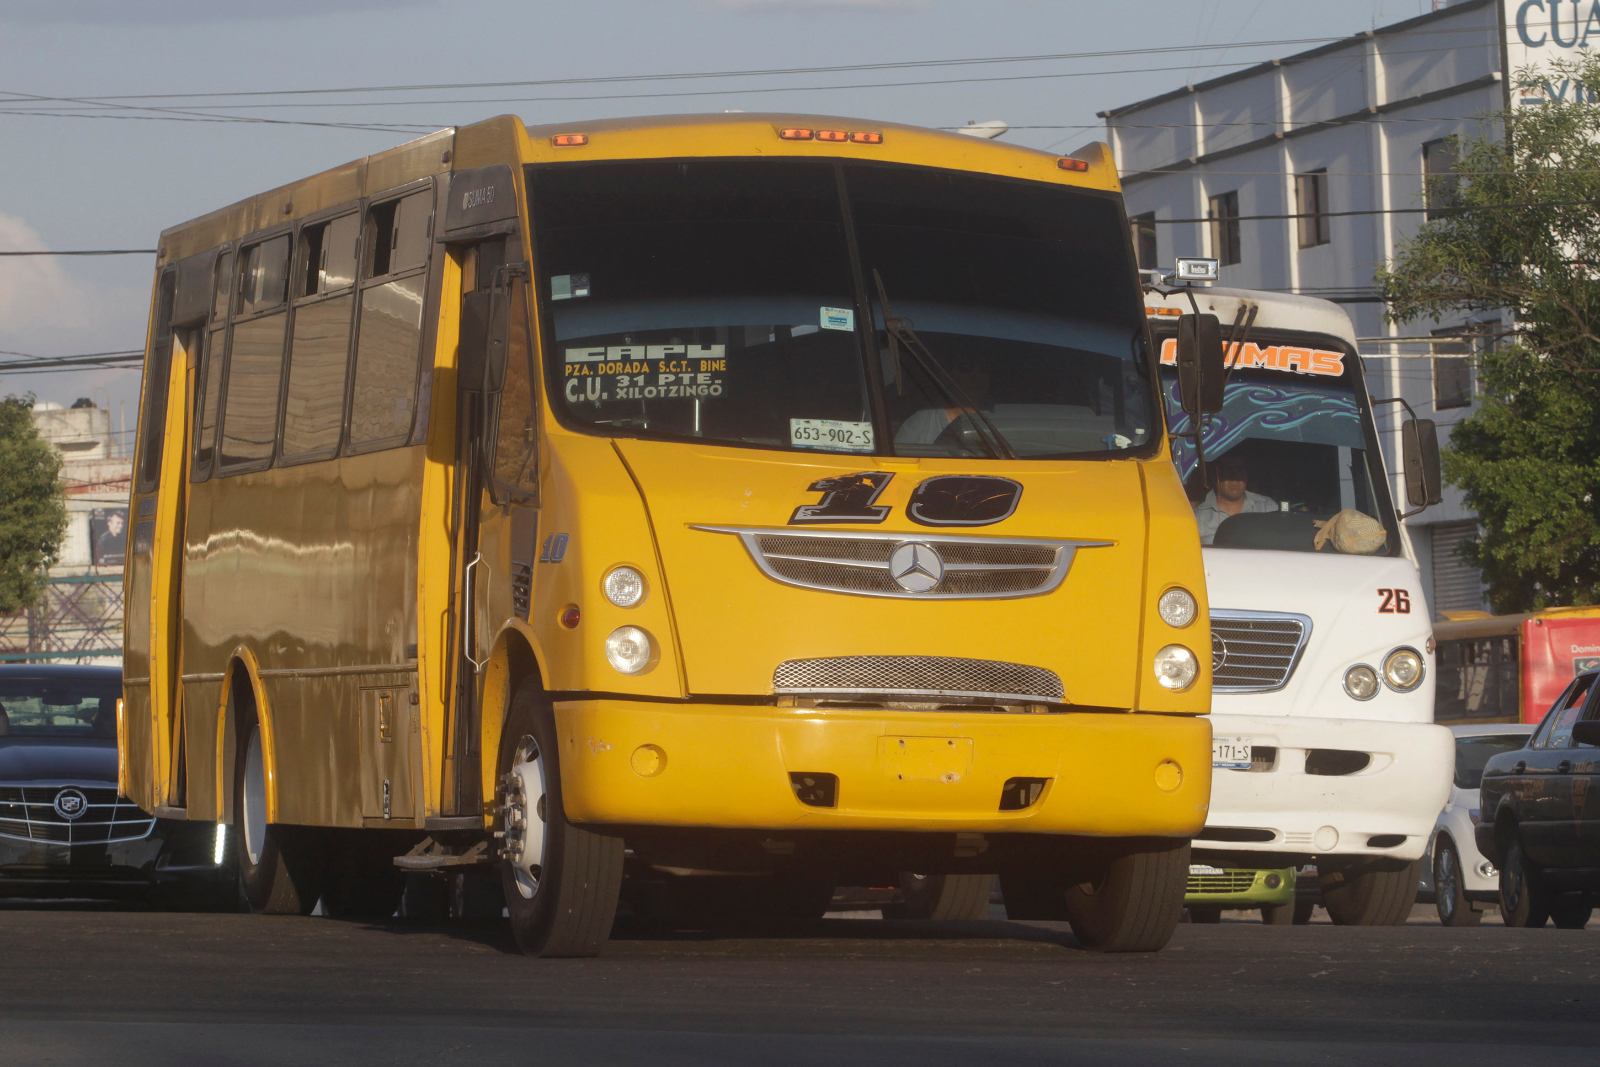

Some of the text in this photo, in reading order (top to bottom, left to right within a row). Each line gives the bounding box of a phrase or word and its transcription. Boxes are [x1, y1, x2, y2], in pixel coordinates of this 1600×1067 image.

[565, 344, 726, 362] CAPU
[565, 359, 727, 376] PZA. DORADA S.C.T. BINE
[565, 373, 723, 403] C.U. 31 PTE.
[615, 384, 723, 399] XILOTZINGO
[794, 426, 872, 445] 653-902-S
[786, 471, 1024, 527] 10
[539, 532, 570, 563] 10
[1376, 587, 1411, 615] 26
